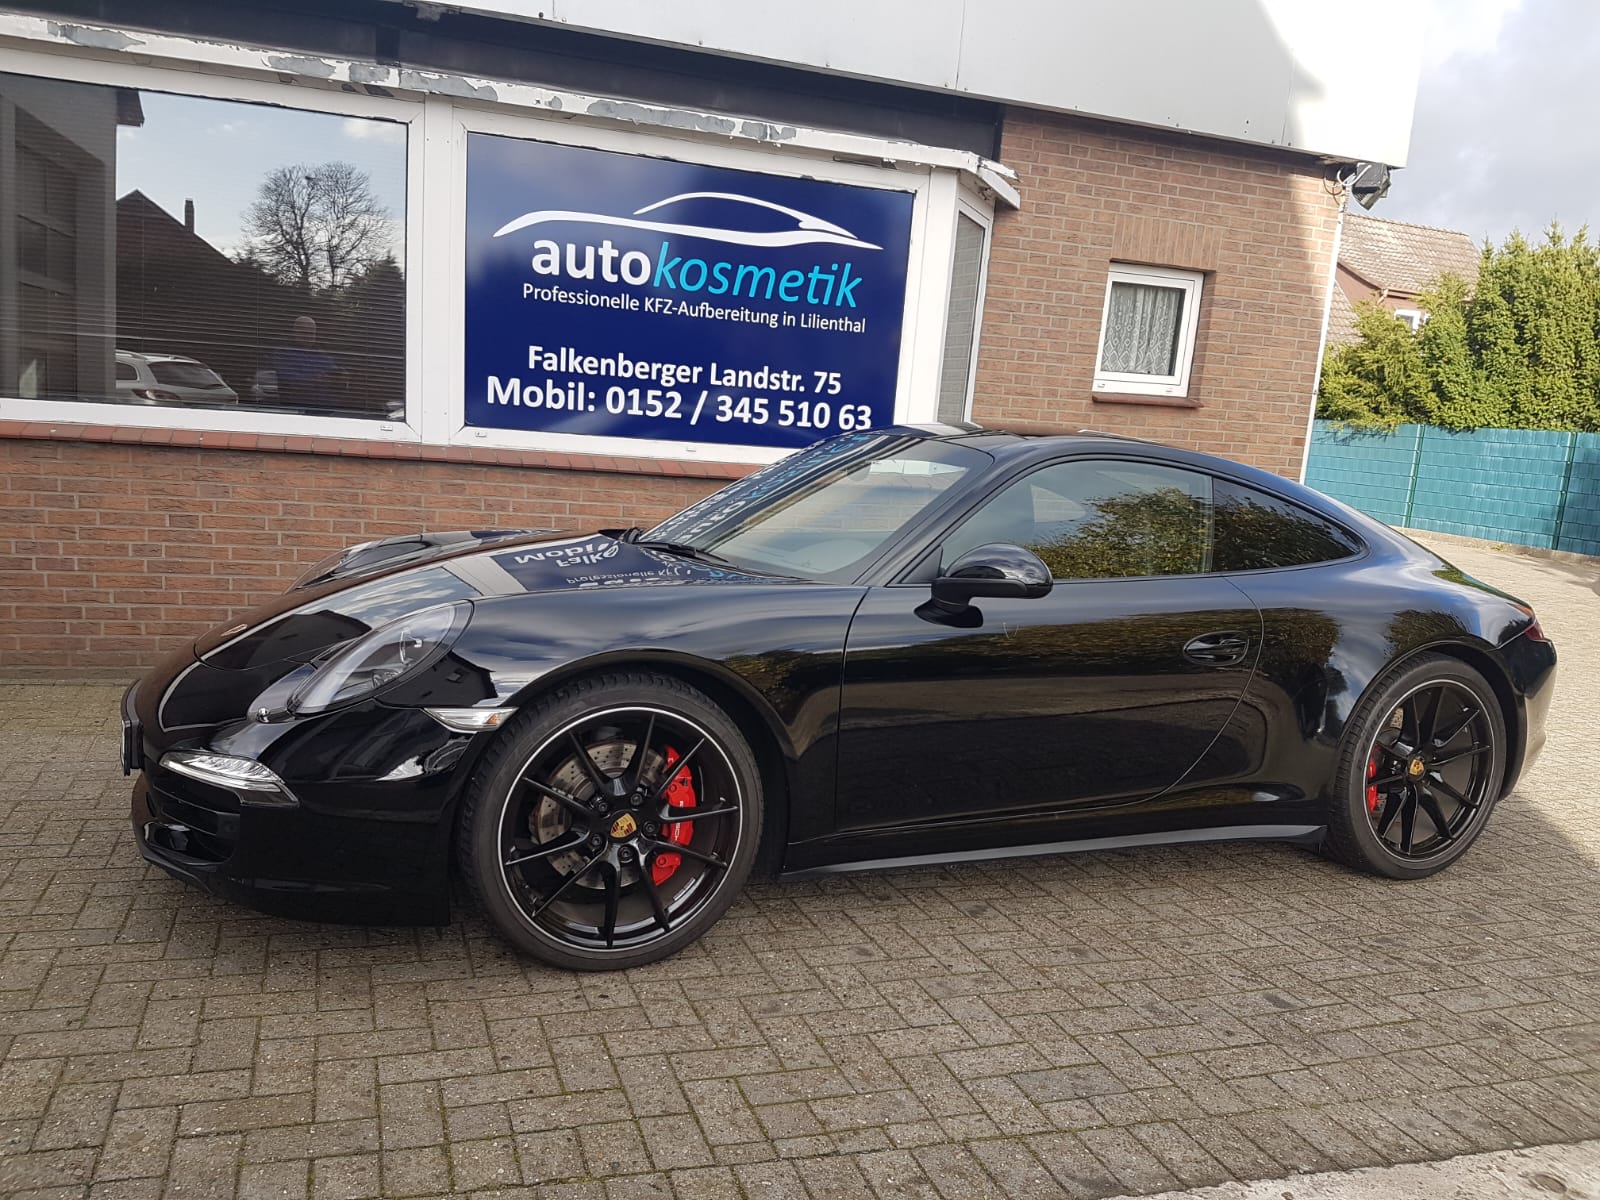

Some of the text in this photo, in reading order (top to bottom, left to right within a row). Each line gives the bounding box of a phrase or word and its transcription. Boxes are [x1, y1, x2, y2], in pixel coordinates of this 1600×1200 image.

[531, 239, 863, 308] autokosmetik
[523, 283, 866, 333] Professionelle KFZ-Aufbereitung in Lilienthal
[528, 345, 842, 394] Falkenberger Landstr. 75
[487, 375, 872, 430] Mobil: 0152 / 345 510 63
